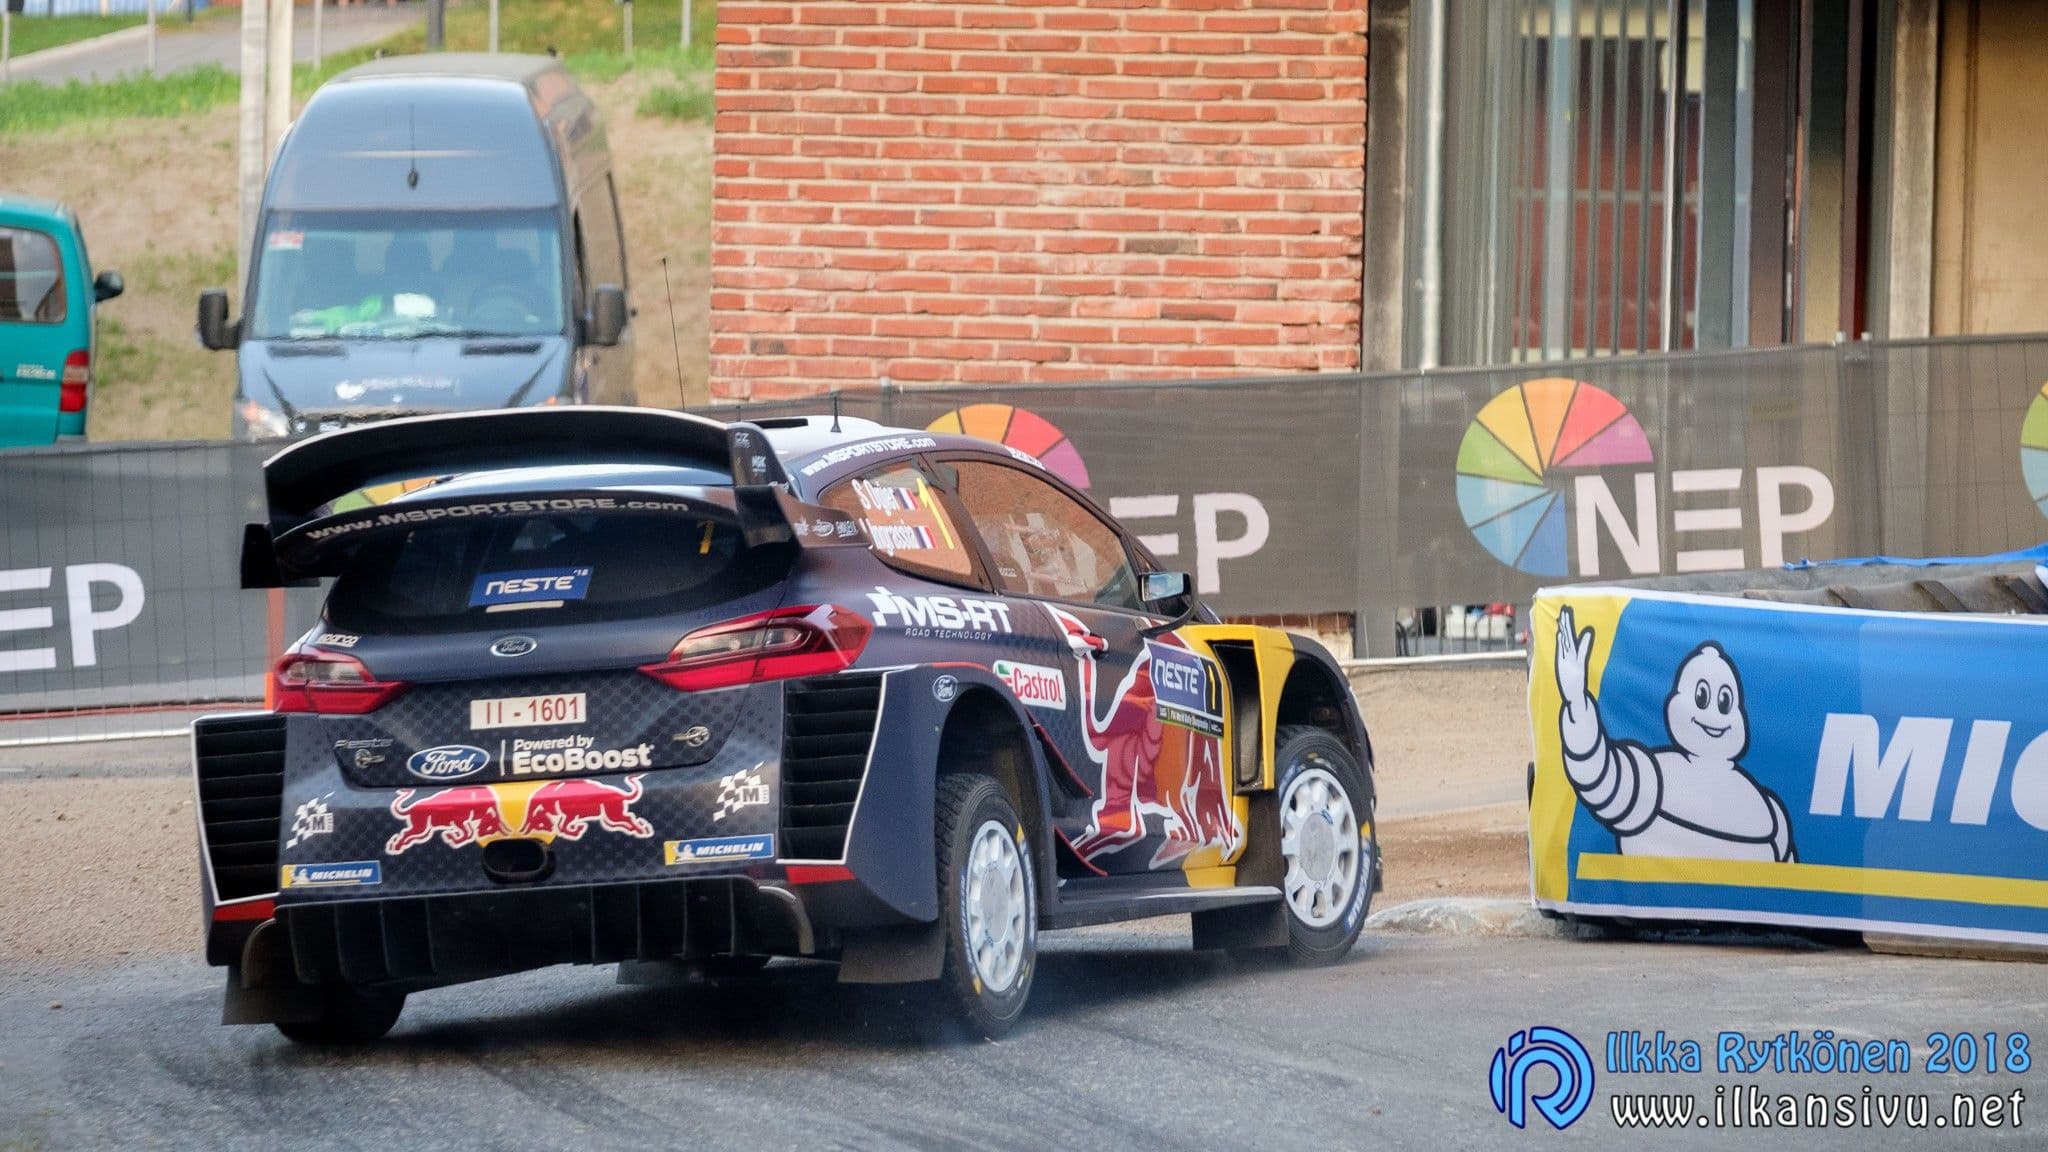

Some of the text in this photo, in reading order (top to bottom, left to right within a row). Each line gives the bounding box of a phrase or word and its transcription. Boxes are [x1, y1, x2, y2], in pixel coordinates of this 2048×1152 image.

[852, 479, 871, 510] S
[306, 498, 689, 539] www.MSPORTSTORE.com
[916, 477, 955, 550] 1
[1575, 466, 1835, 577] NEP
[485, 575, 574, 596] NESTE
[892, 596, 1013, 633] MS-RT
[905, 628, 992, 640] ROAD TECHNOLOGY
[1013, 668, 1063, 704] Castrol
[1155, 658, 1199, 695] NESTE
[1207, 665, 1216, 711] 1
[528, 696, 579, 723] 1601
[513, 734, 595, 751] Powered by
[421, 748, 475, 776] Ford
[513, 743, 653, 775] EcoBoost
[695, 840, 764, 856] MICHELIN
[310, 867, 372, 882] MICHELIN
